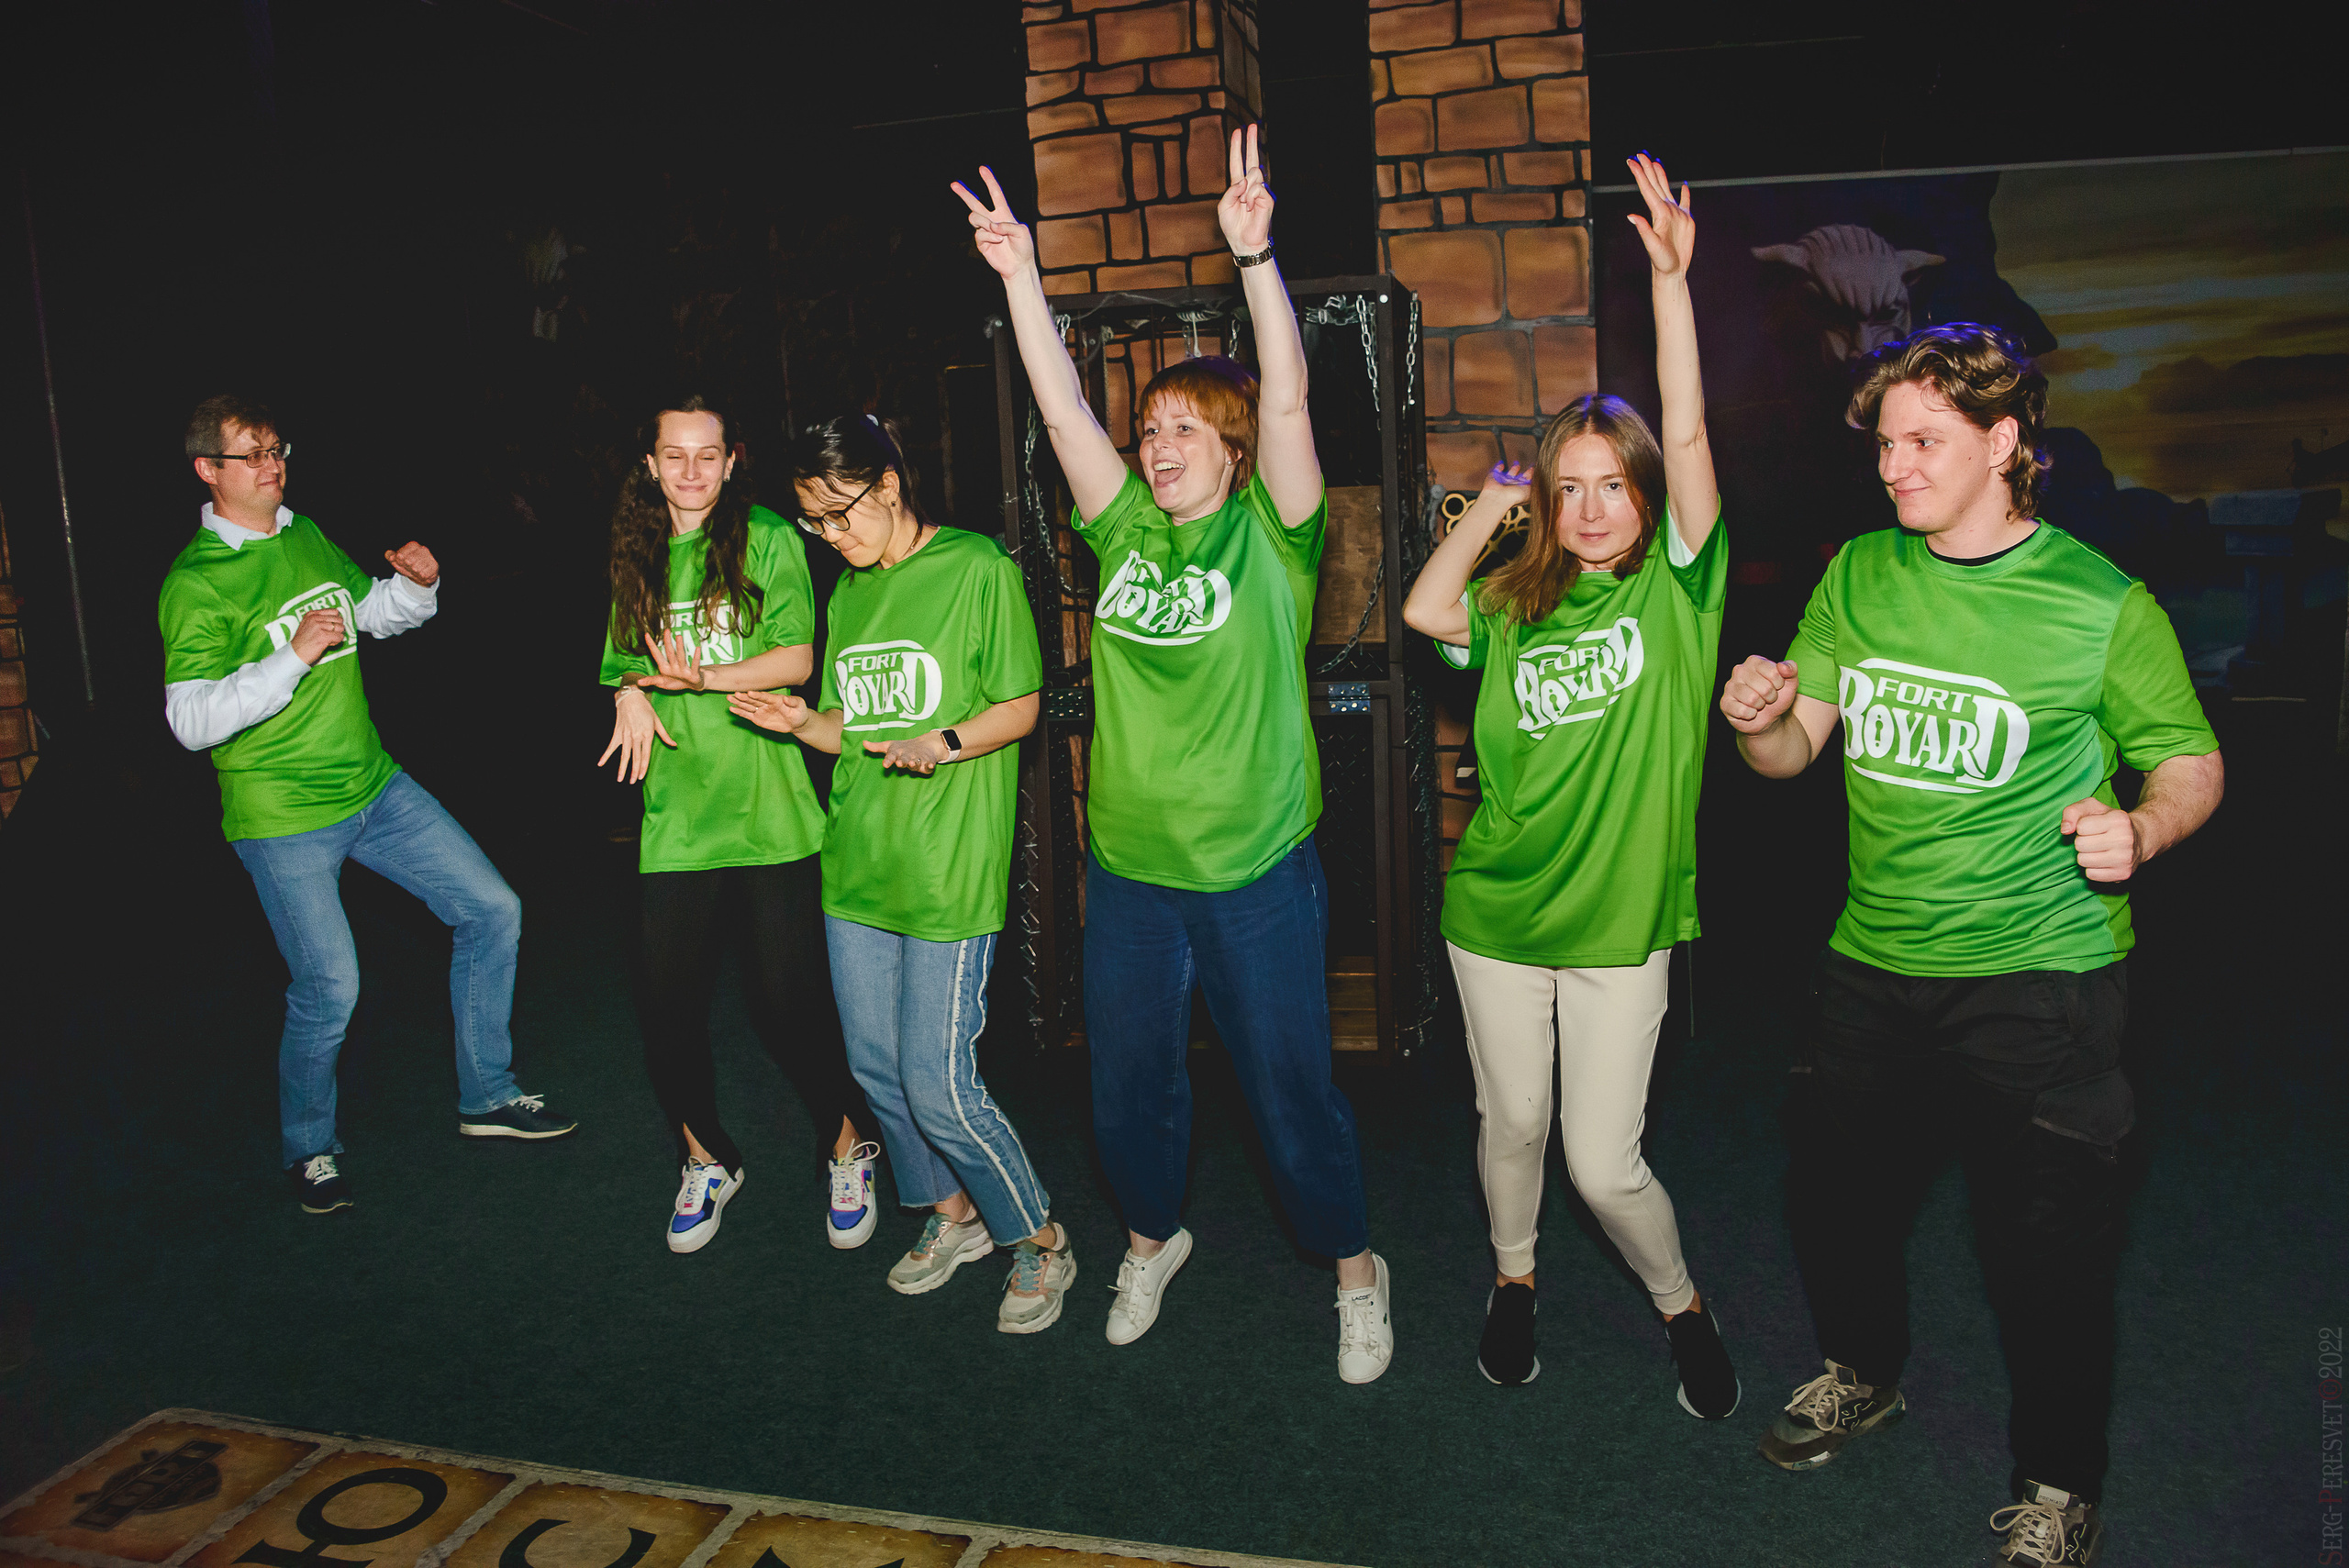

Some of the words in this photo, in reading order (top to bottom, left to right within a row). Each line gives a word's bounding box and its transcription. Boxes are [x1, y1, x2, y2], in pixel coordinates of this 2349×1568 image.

[848, 652, 900, 673] FORT
[1538, 644, 1605, 675] FOR
[1876, 676, 1971, 713] FORT
[1838, 665, 2030, 787] BOYARD
